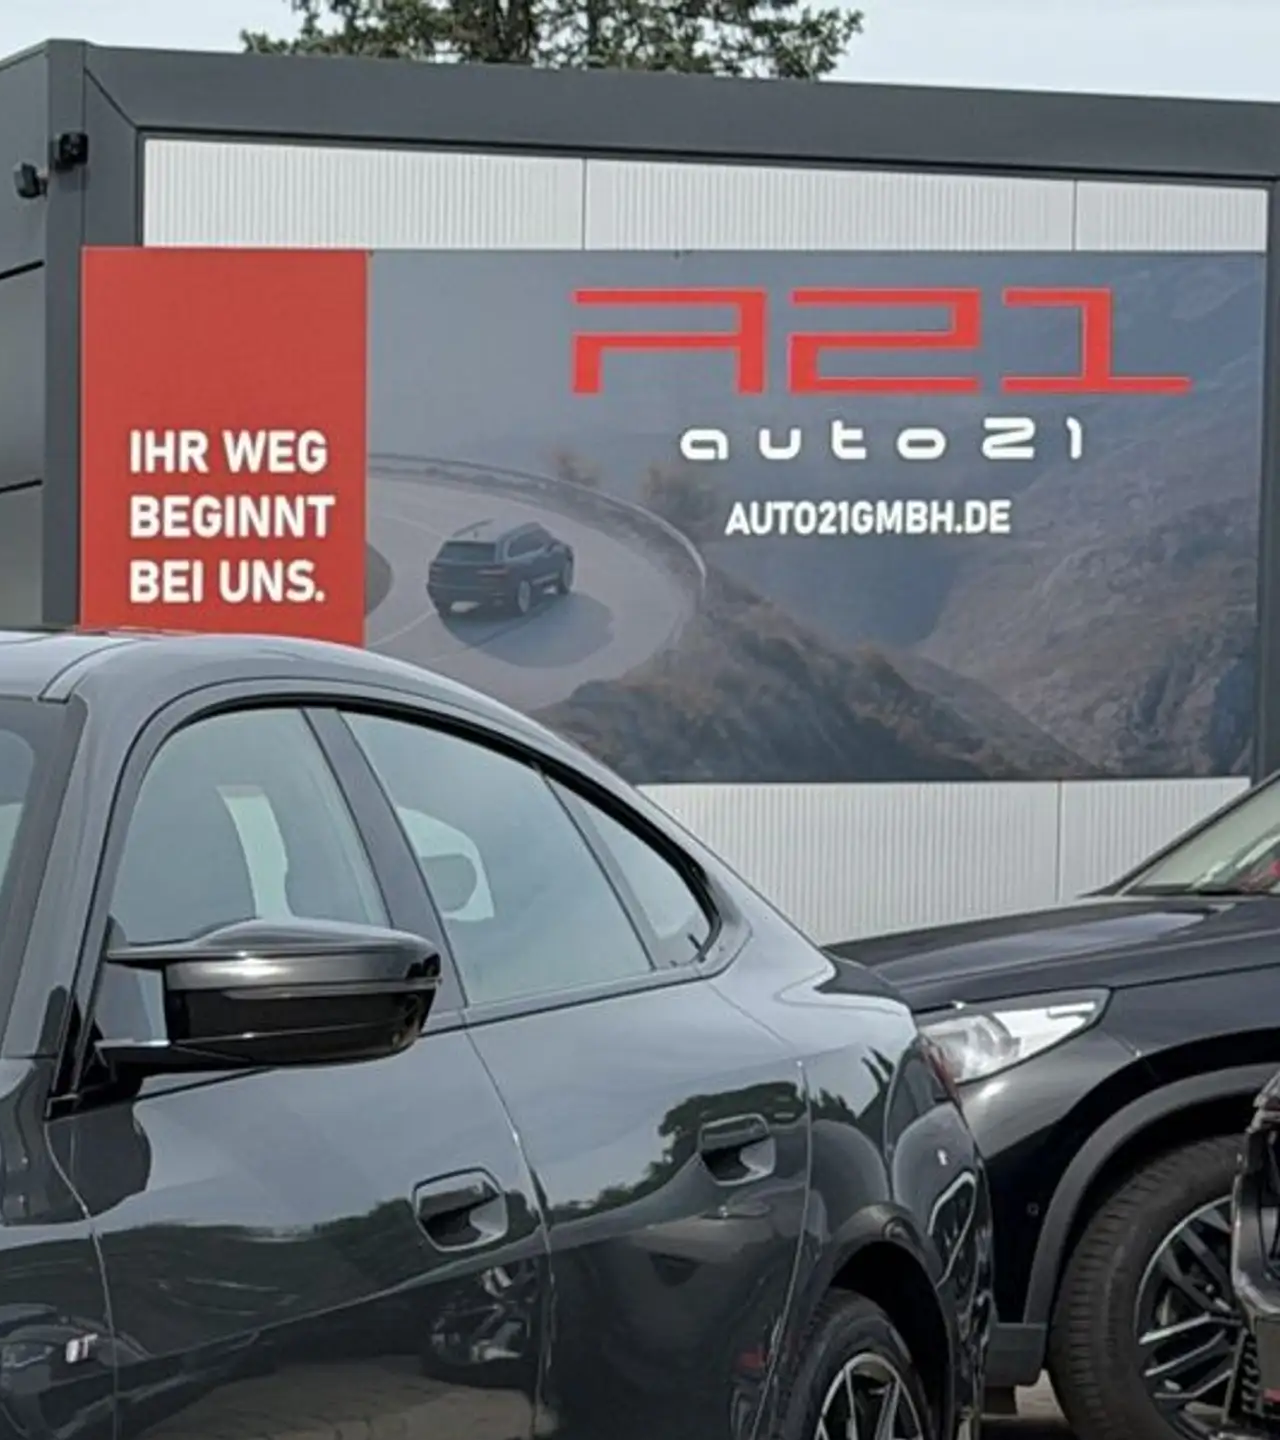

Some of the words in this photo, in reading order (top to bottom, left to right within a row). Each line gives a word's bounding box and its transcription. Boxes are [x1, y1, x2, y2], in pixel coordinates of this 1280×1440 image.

[571, 287, 1192, 395] A21
[129, 430, 208, 473] IHR
[222, 430, 328, 473] WEG
[129, 495, 336, 538] BEGINNT
[724, 500, 1012, 536] AUTO21GMBH.DE
[129, 560, 205, 603] BEI
[219, 560, 325, 603] UNS.
